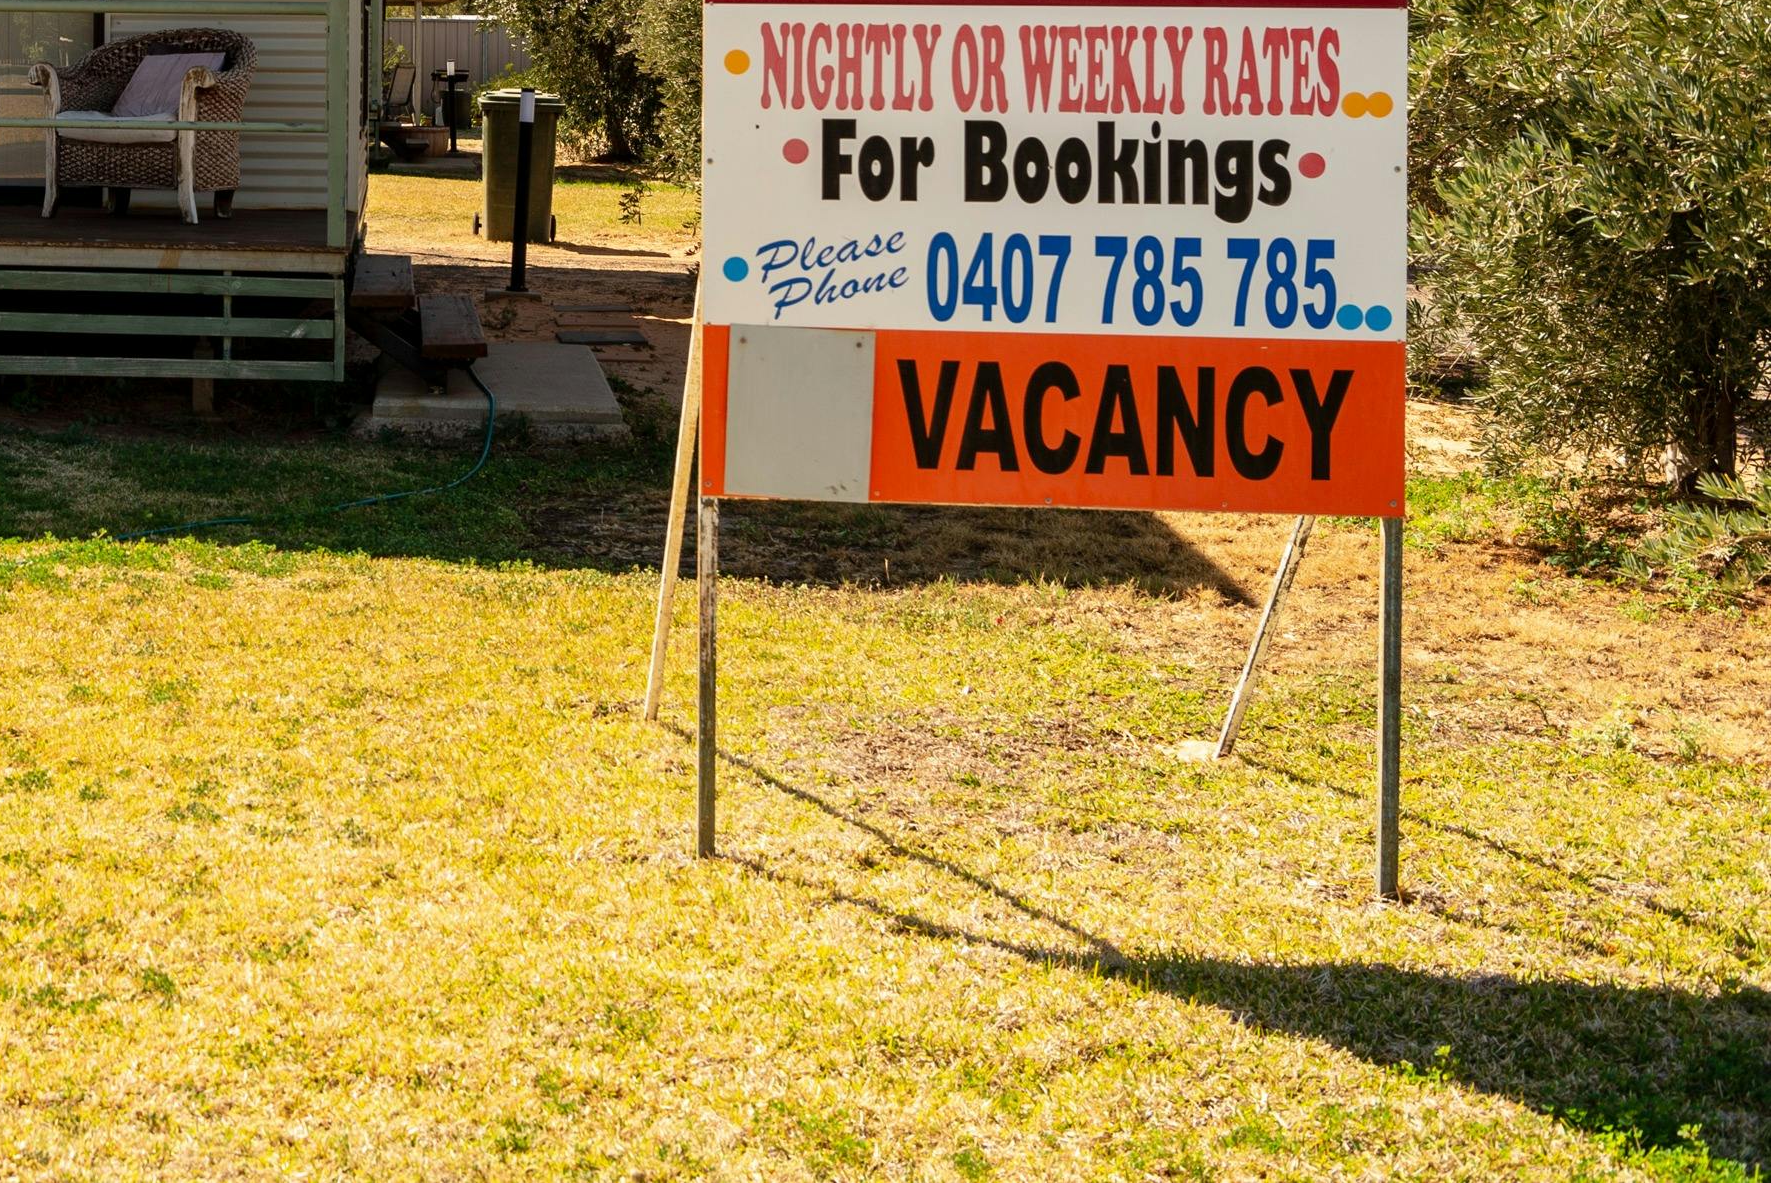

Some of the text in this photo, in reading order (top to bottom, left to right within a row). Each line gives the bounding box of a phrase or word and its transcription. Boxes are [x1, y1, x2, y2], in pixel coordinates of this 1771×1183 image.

[760, 21, 1341, 118] NIGHTLY OR WEEKLY RATES
[821, 118, 1292, 224] For Bookings
[755, 230, 906, 278] Please
[769, 264, 910, 319] Phone
[927, 232, 1338, 328] 0407 785 785
[897, 359, 1355, 481] VACANCY
